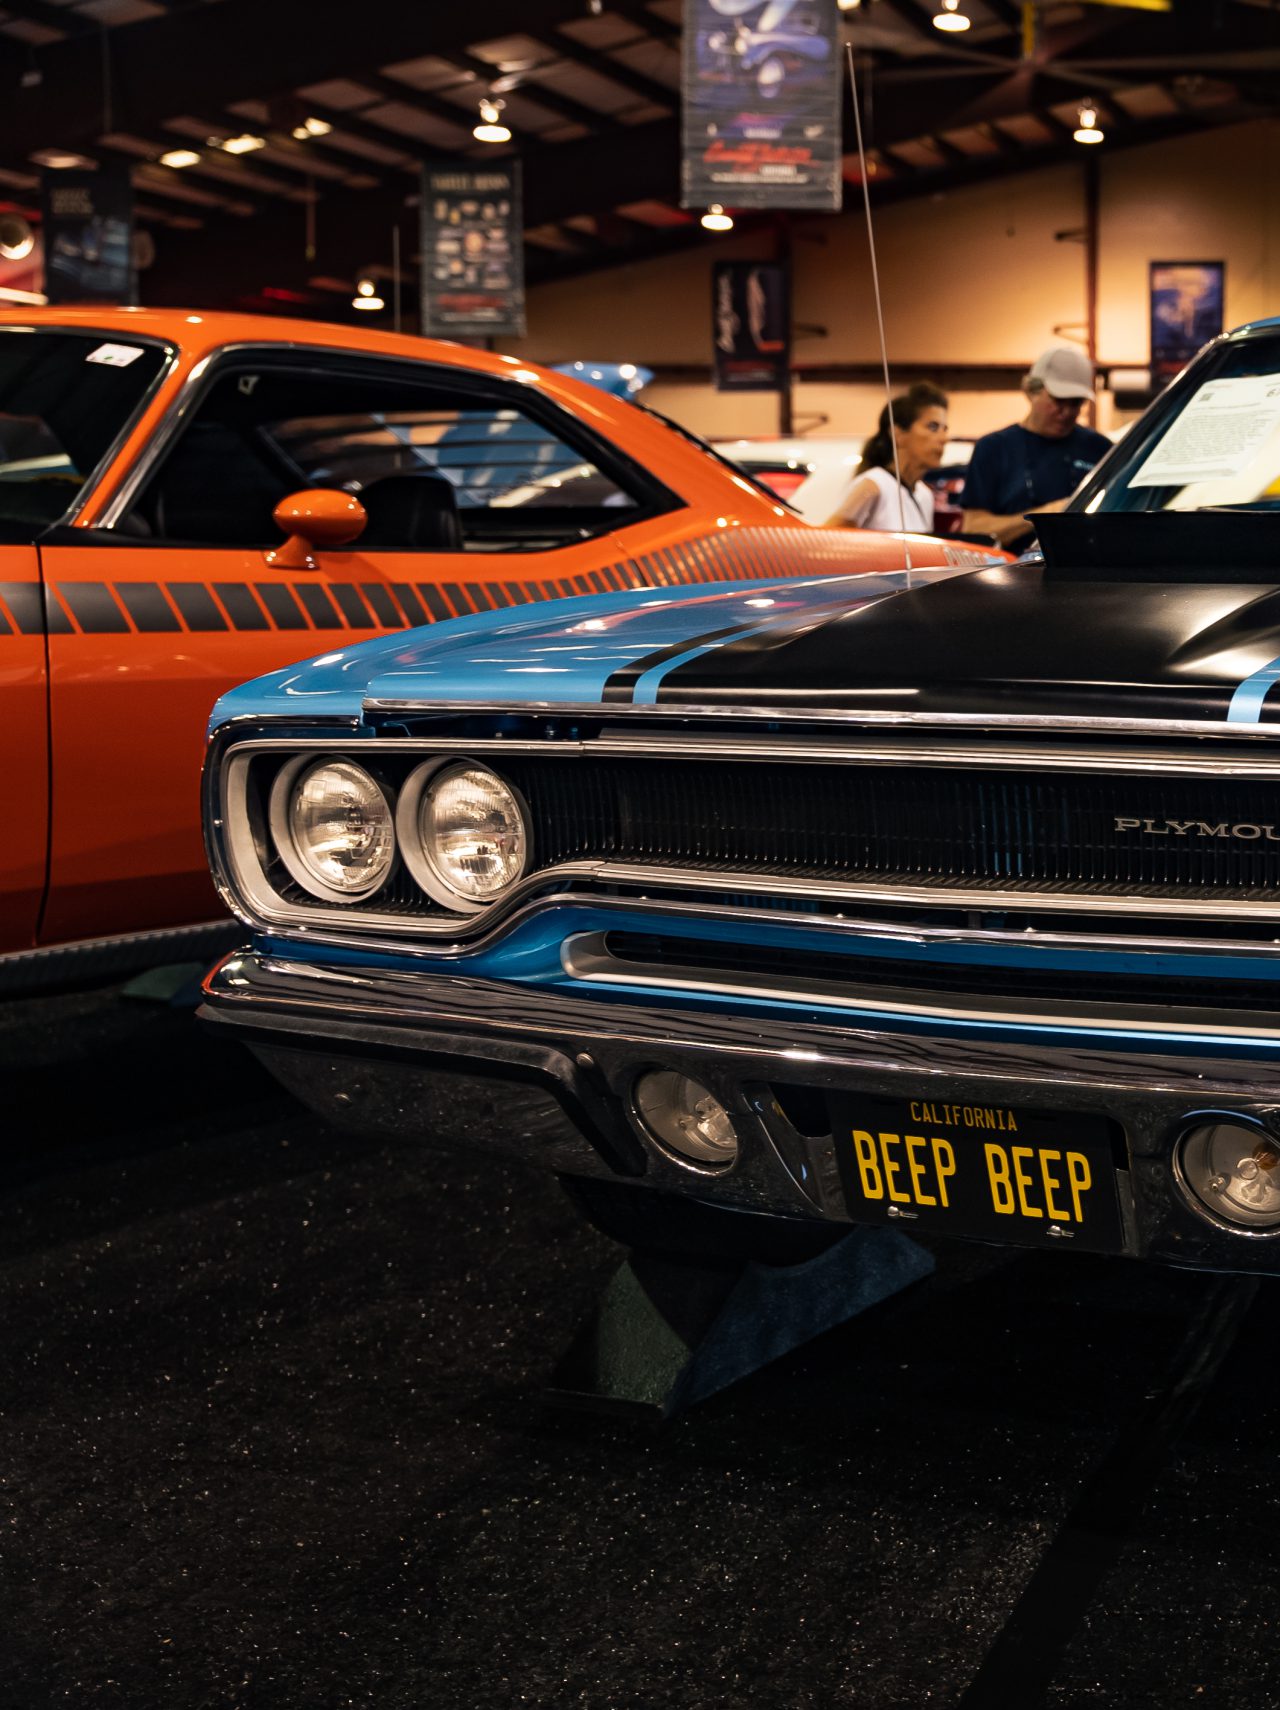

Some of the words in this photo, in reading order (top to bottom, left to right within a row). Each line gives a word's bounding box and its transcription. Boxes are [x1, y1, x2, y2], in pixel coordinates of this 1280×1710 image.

[910, 1102, 1018, 1132] CALIFORNIA
[852, 1129, 957, 1208] BEEP
[983, 1142, 1092, 1223] BEEP
